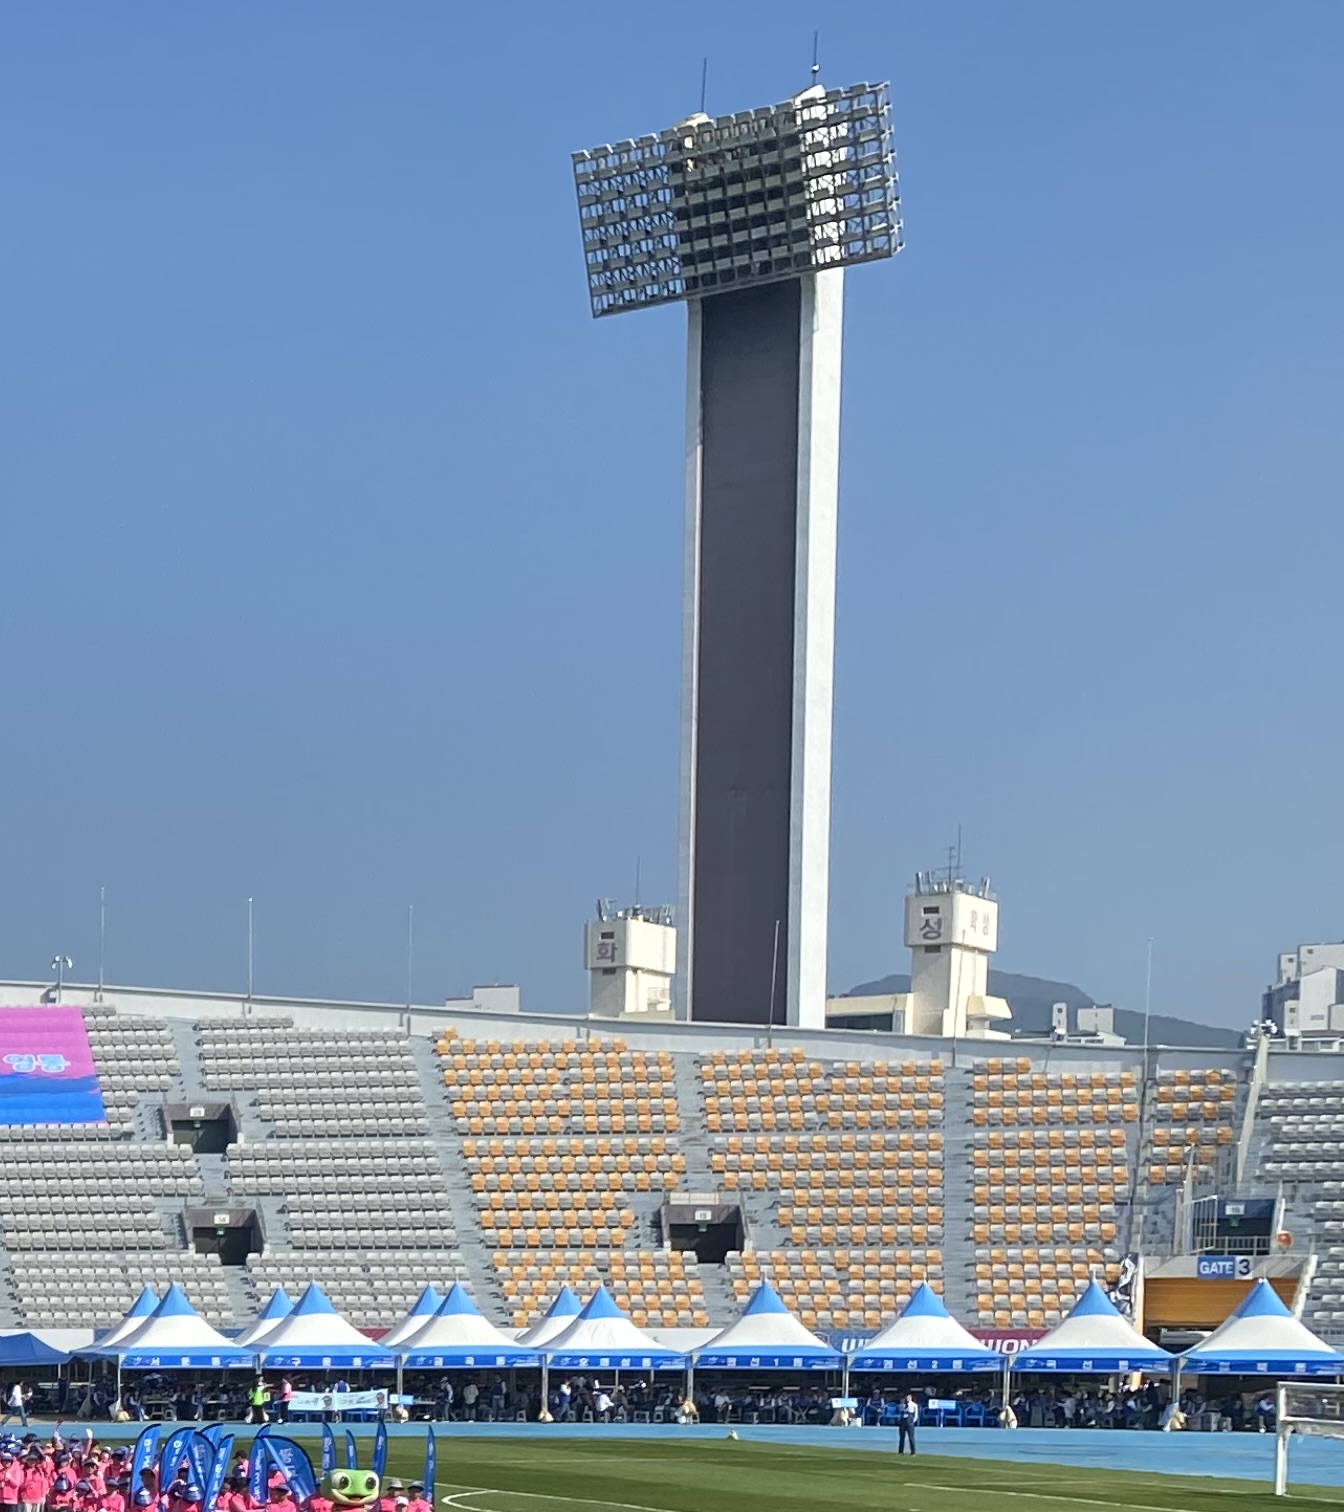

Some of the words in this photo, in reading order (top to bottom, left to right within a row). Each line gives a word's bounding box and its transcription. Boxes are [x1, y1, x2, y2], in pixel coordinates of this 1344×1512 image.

[918, 917, 943, 940] 성
[595, 940, 619, 963] 화
[1199, 1261, 1234, 1275] GATE
[1237, 1258, 1251, 1276] 3
